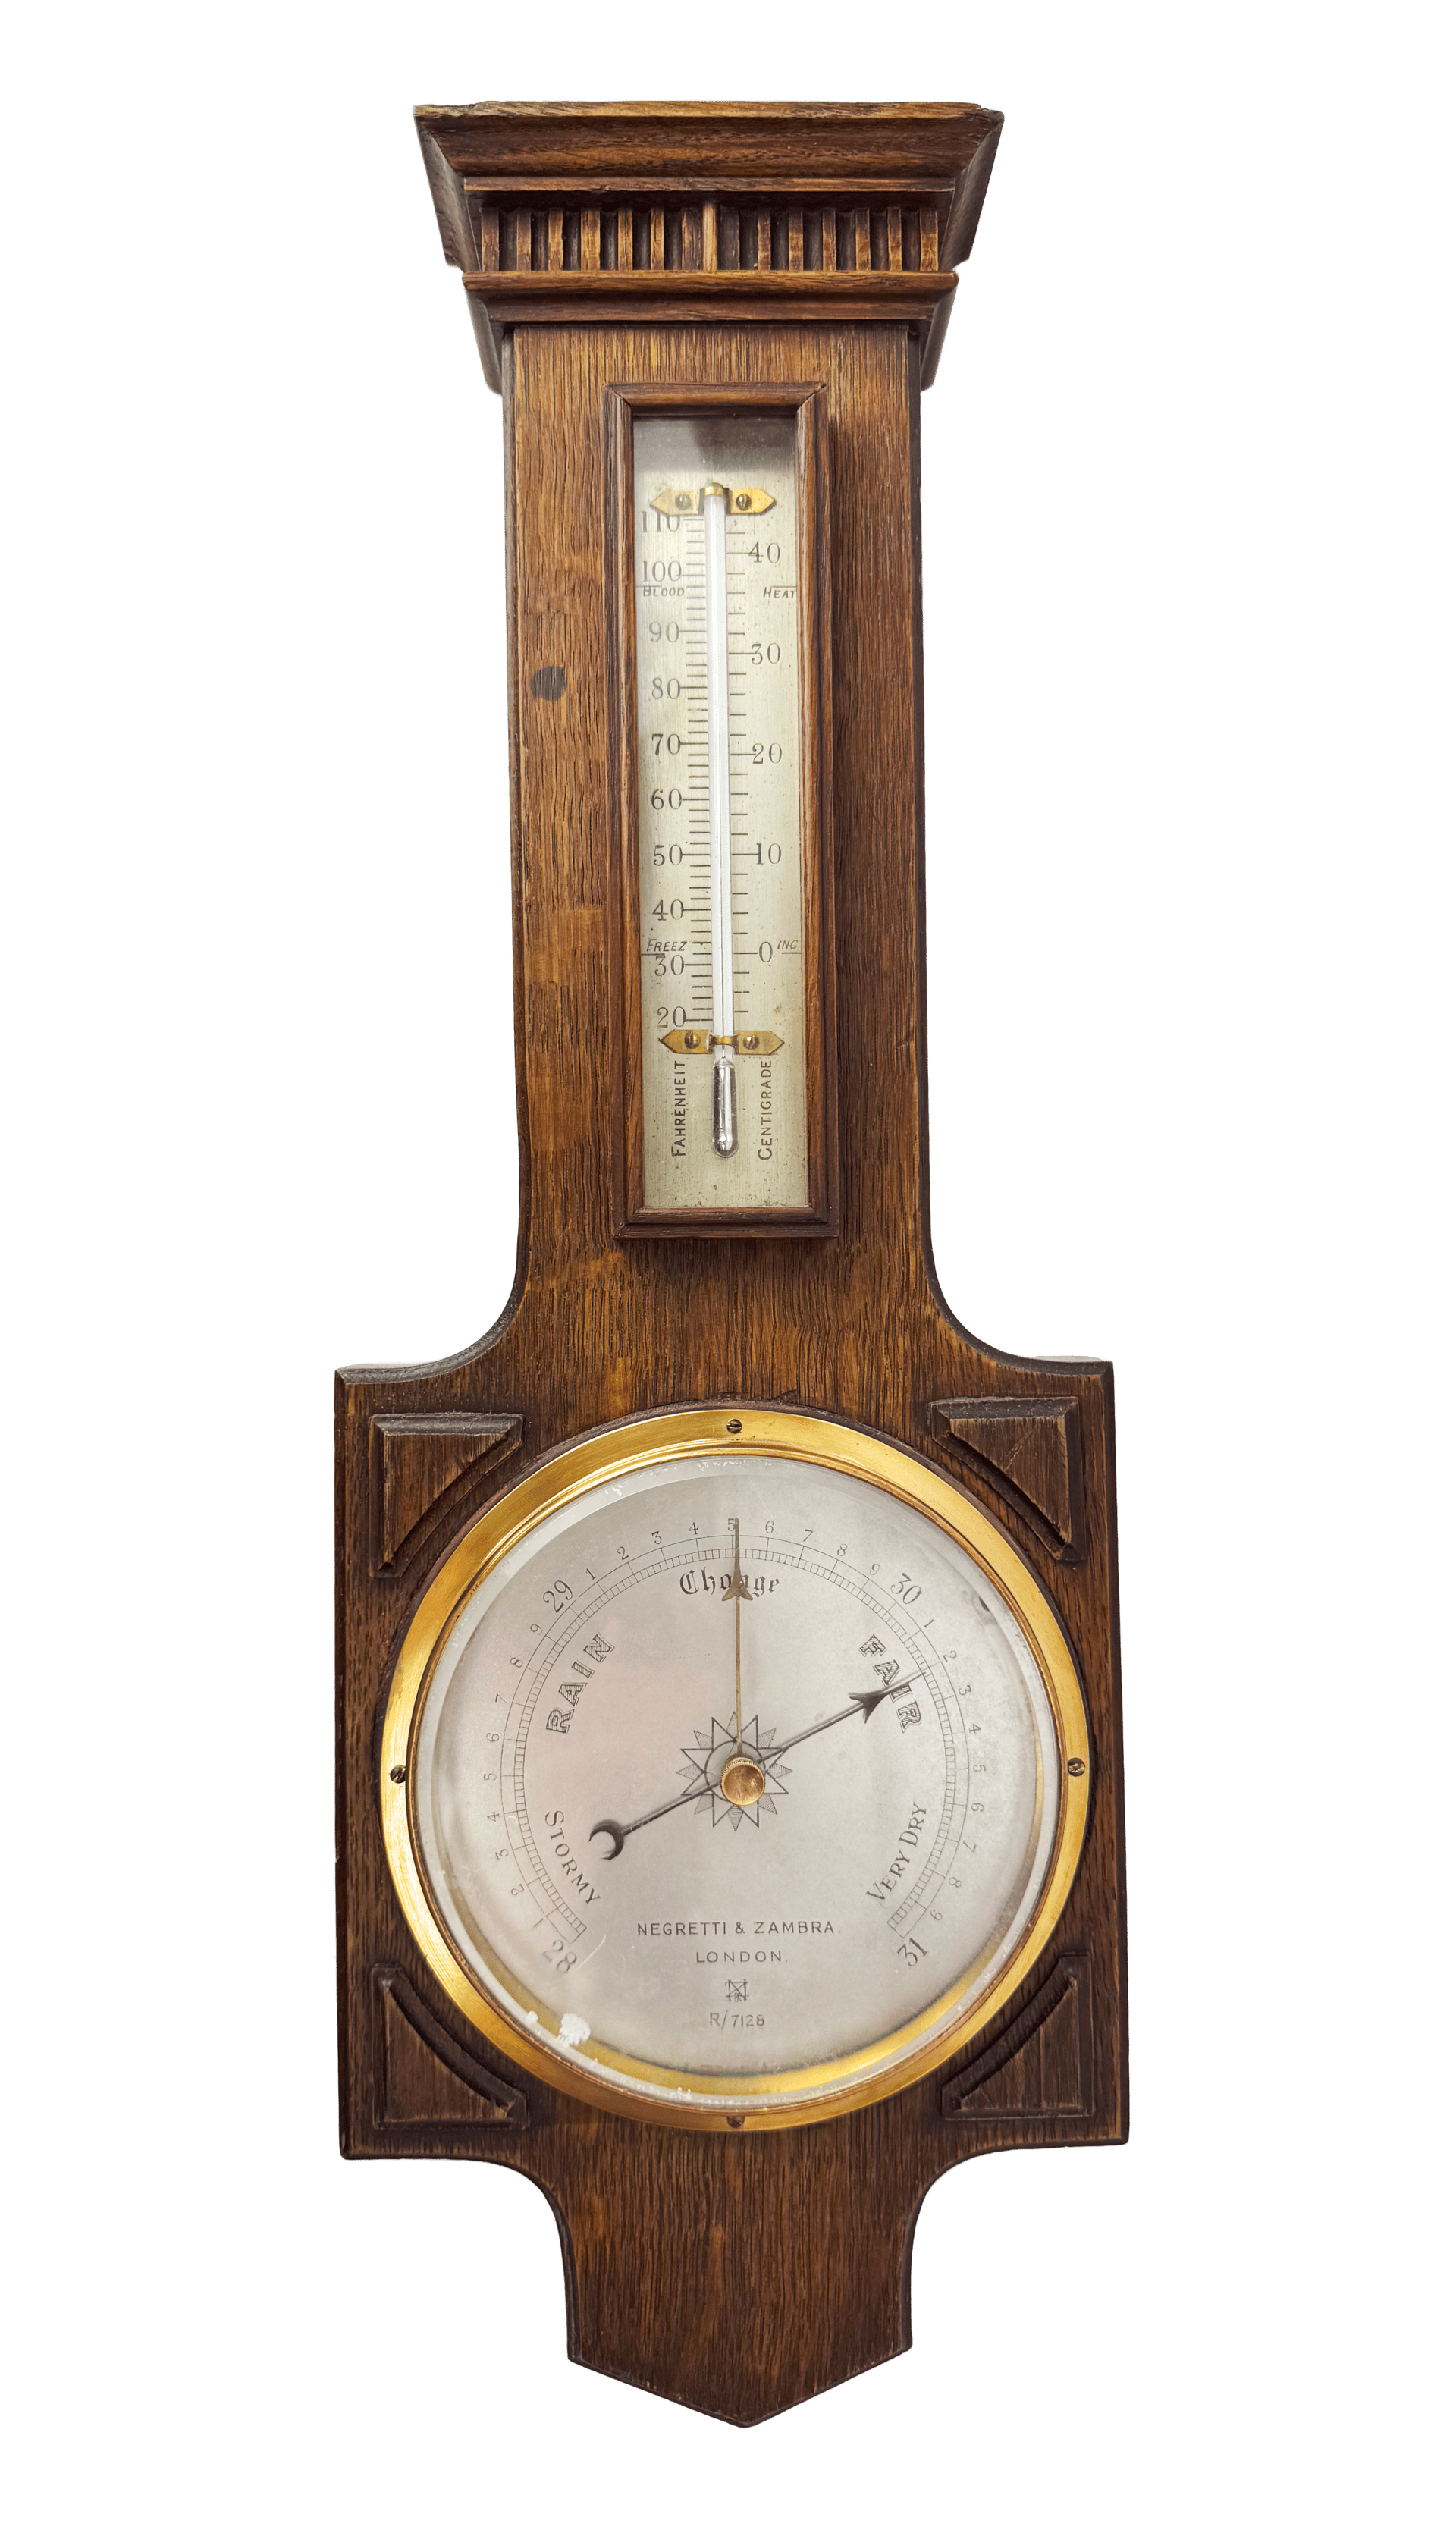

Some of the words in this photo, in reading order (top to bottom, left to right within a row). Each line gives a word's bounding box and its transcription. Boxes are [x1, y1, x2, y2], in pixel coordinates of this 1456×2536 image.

[748, 541, 781, 564] 40
[641, 560, 682, 582] 100
[642, 587, 685, 598] BLOOD
[763, 587, 795, 598] HEAT
[648, 622, 680, 643] 90
[751, 642, 781, 665] 30
[651, 678, 681, 700] 80
[651, 733, 681, 756] 70
[752, 742, 783, 765] 20
[651, 788, 682, 810] 60
[653, 844, 683, 866] 50
[755, 843, 782, 865] 10
[651, 899, 684, 921] 40
[645, 939, 688, 953] FREEZ
[758, 941, 774, 963] 0
[654, 954, 685, 977] 30
[657, 1006, 686, 1028] 20
[670, 1060, 686, 1157] FAHRENHEIT
[757, 1059, 773, 1161] CENTIGRADE
[689, 1521, 699, 1535] 4
[727, 1518, 736, 1532] 5
[764, 1520, 775, 1534] 6
[651, 1530, 663, 1545] 3
[802, 1529, 814, 1543] 7
[617, 1546, 629, 1561] 2
[836, 1543, 848, 1557] 8
[585, 1567, 597, 1580] 1
[869, 1563, 880, 1576] 9
[890, 1572, 922, 1605] 30
[542, 1580, 574, 1613] 29
[529, 1623, 543, 1636] 9
[923, 1618, 935, 1629] 1
[510, 1656, 523, 1668] 8
[942, 1649, 958, 1663] 2
[545, 1631, 616, 1734] RAIN
[858, 1634, 922, 1734] FAIR
[958, 1684, 972, 1696] 3
[494, 1693, 508, 1704] 7
[968, 1722, 982, 1734] 4
[485, 1731, 500, 1743] 6
[972, 1763, 987, 1773] 5
[483, 1772, 497, 1781] 5
[970, 1802, 985, 1813] 6
[486, 1810, 500, 1823] 4
[864, 1850, 911, 1902] VERY
[898, 1801, 927, 1847] DRY
[962, 1840, 977, 1853] 7
[494, 1847, 510, 1861] 3
[544, 1809, 601, 1905] STORMY
[948, 1876, 962, 1888] 8
[510, 1883, 526, 1897] 2
[930, 1909, 943, 1921] 9
[532, 1917, 544, 1929] 1
[637, 1922, 726, 1935] NEGRETTI
[734, 1921, 745, 1935] &
[541, 1939, 578, 1973] 28
[695, 1950, 788, 1963] LONDON.
[896, 1937, 929, 1967] 31
[709, 2009, 766, 2031] R/7128
